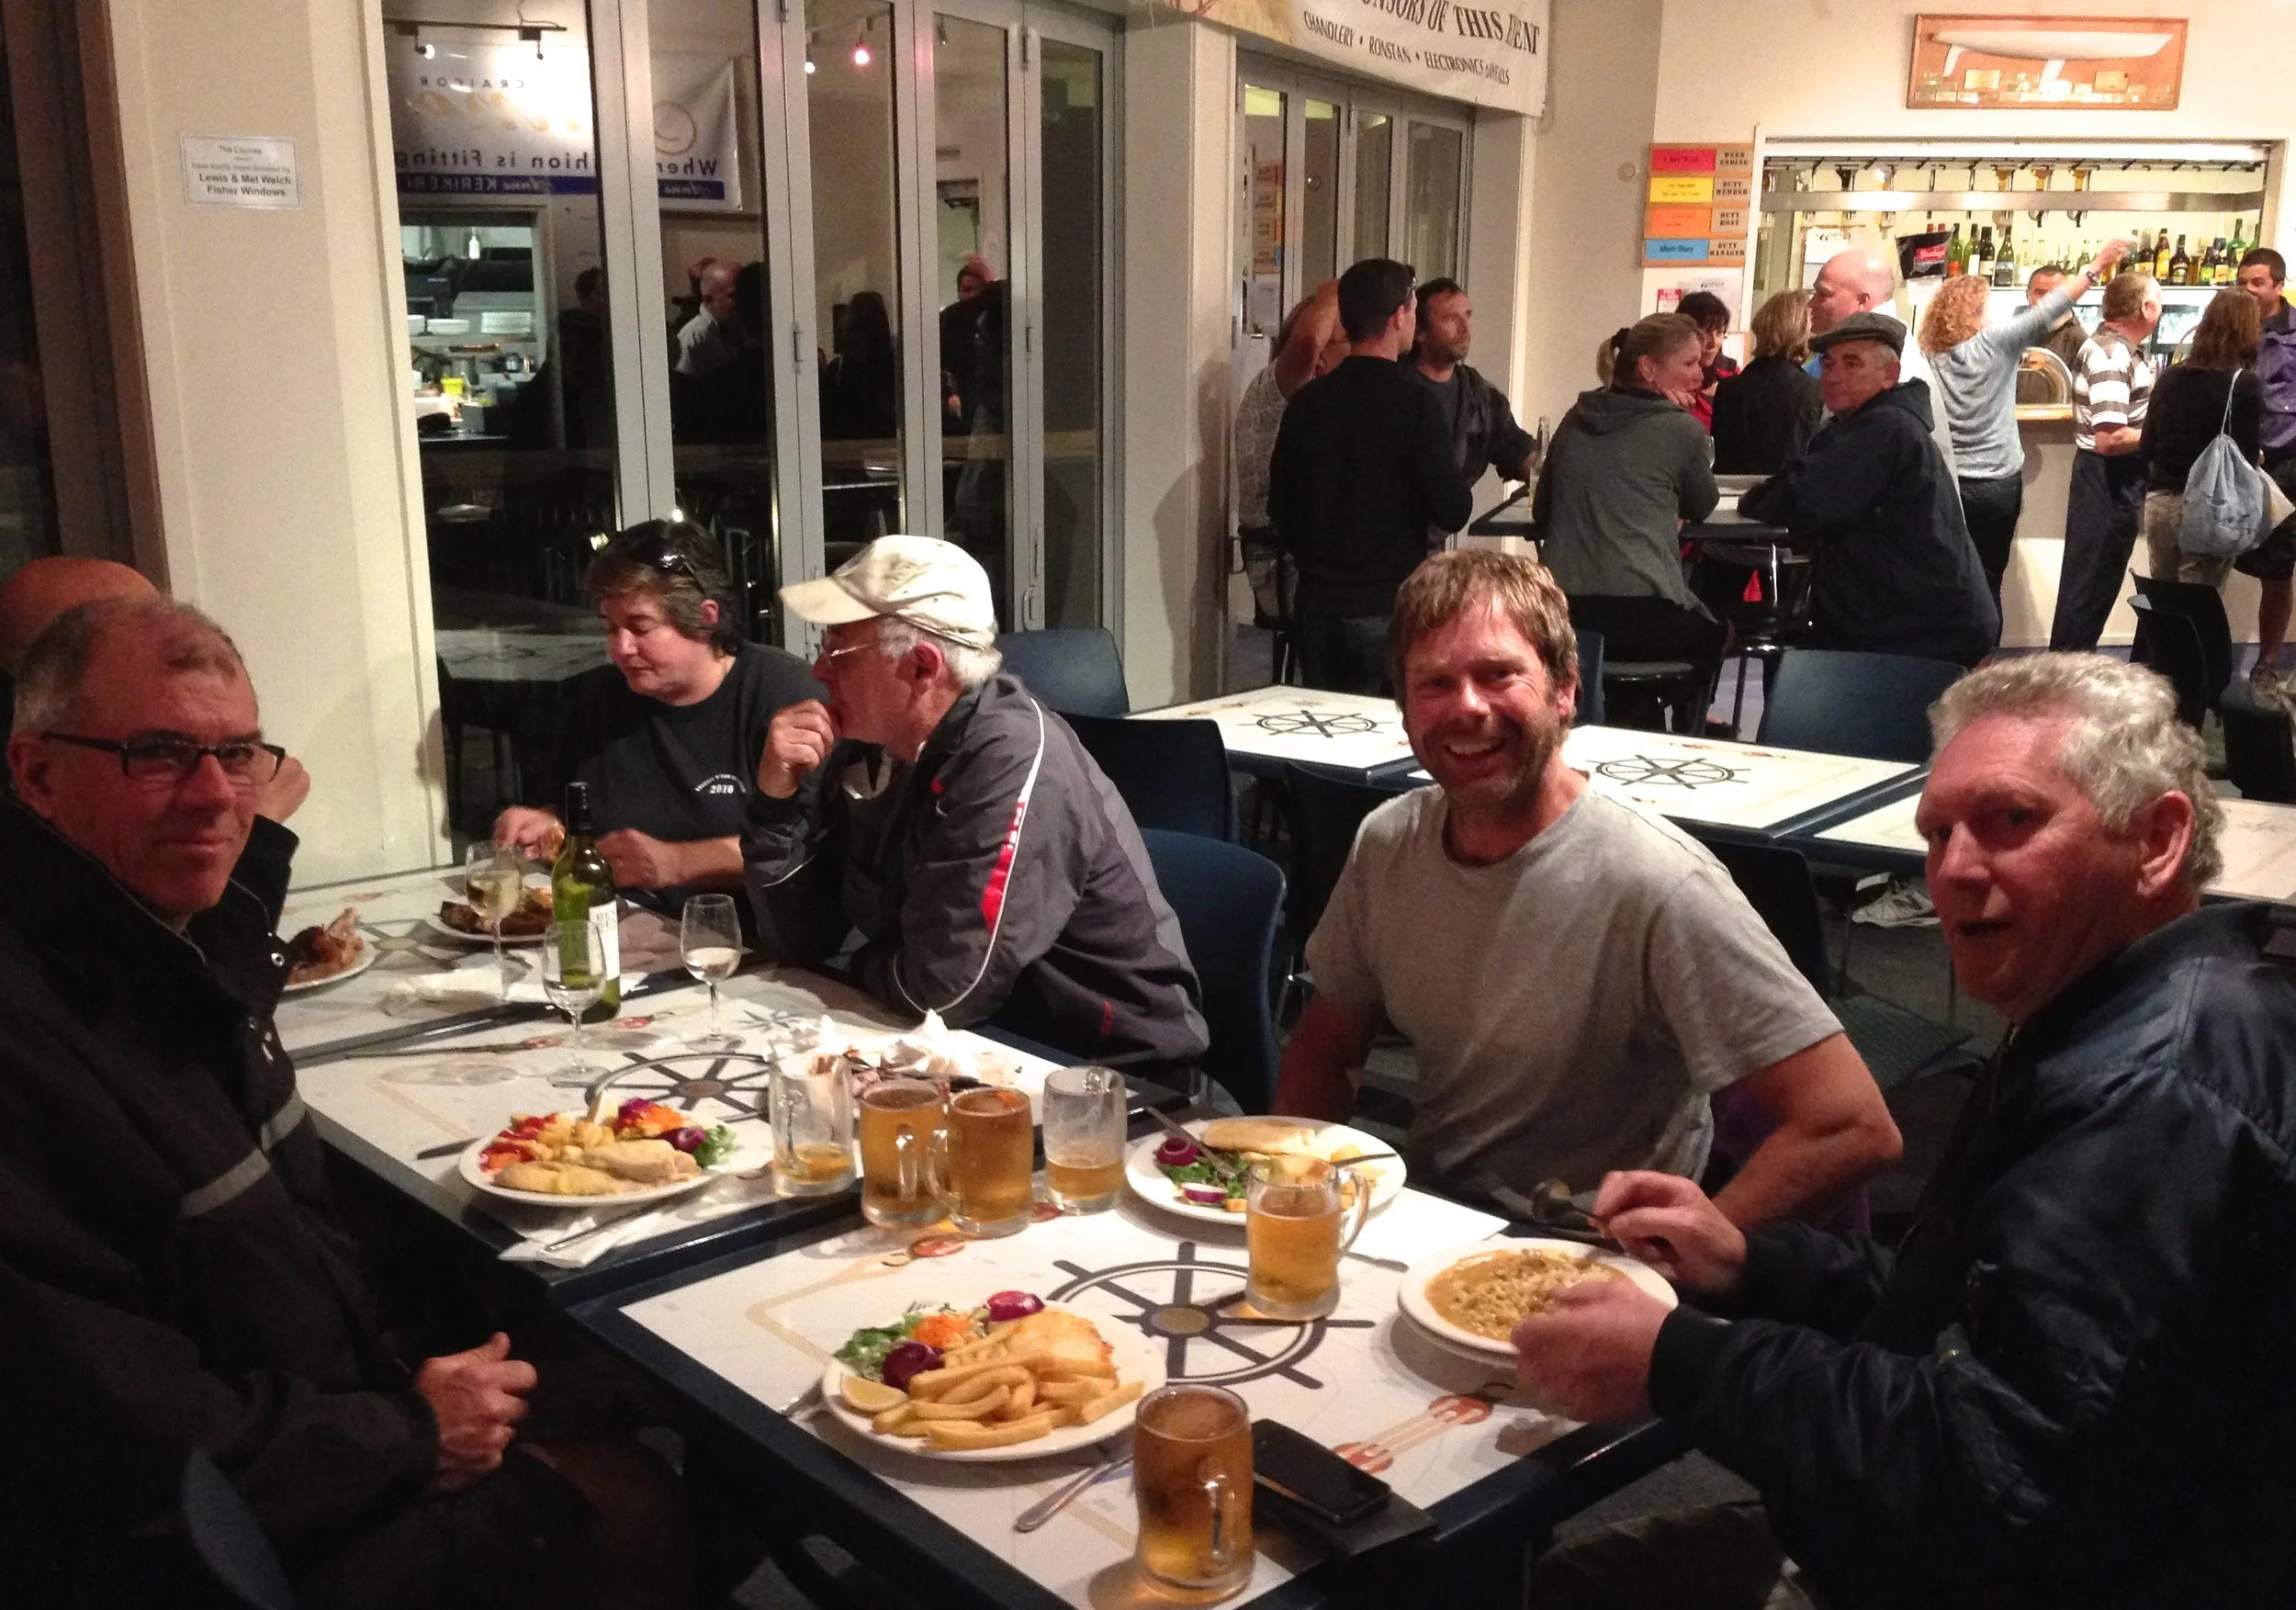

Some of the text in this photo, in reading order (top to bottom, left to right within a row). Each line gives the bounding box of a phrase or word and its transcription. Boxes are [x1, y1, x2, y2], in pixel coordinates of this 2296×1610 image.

[1360, 0, 1425, 26] NSORS
[1428, 0, 1447, 33] OF
[1453, 6, 1503, 41] THIS
[1303, 11, 1354, 48] CHANDLERY
[1368, 36, 1412, 63] RONSTAN
[1424, 51, 1484, 75] ELECTRONICS
[198, 173, 291, 185] Lewis & Mel Welch
[207, 185, 286, 197] Fisher Windows
